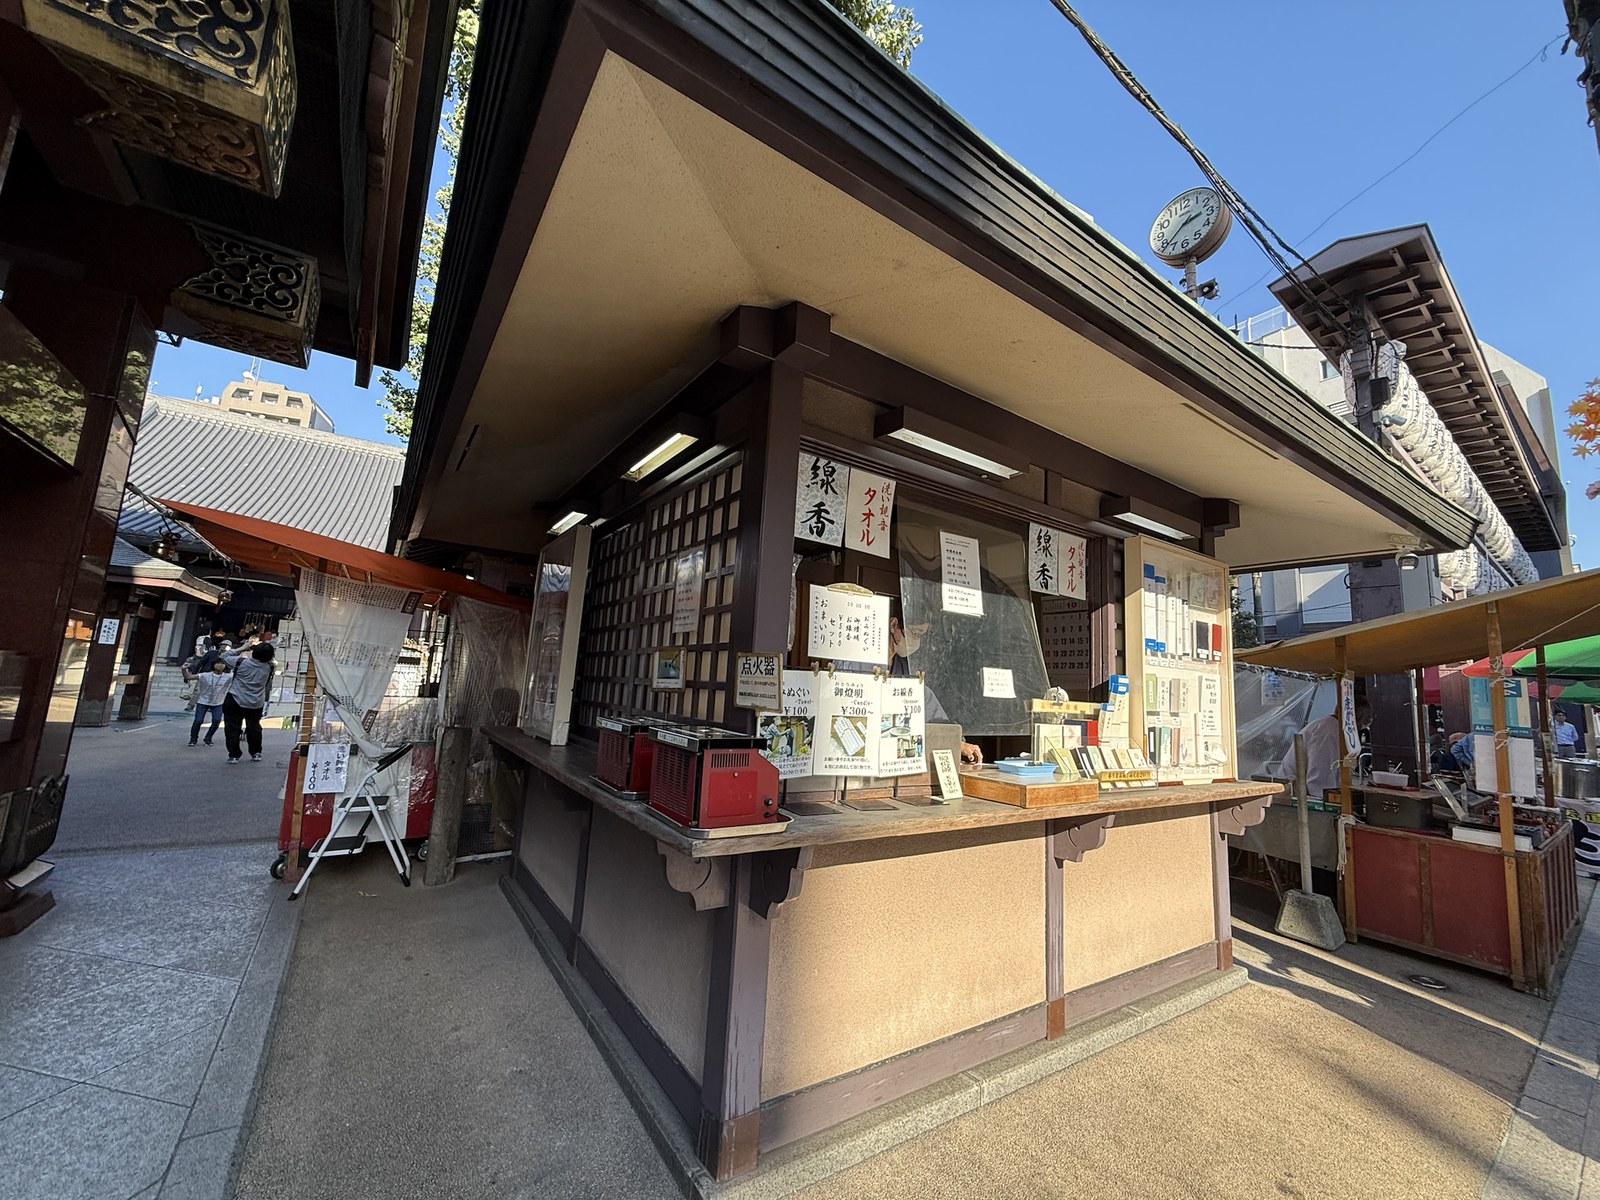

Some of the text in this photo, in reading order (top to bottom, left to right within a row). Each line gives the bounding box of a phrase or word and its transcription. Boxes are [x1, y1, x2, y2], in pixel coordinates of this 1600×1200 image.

[1180, 199, 1190, 211] 12
[1203, 197, 1210, 208] 2
[1168, 207, 1177, 218] 11
[1206, 206, 1214, 216] 3
[1157, 219, 1170, 230] 10
[1203, 218, 1210, 227] 4
[1157, 232, 1164, 241] 9
[1194, 230, 1201, 240] 5
[1161, 239, 1168, 249] 8
[1171, 241, 1178, 251] 7
[1181, 239, 1189, 248] 6
[800, 456, 838, 538] 線香
[877, 482, 893, 532] 洗い観音
[859, 488, 877, 547] タオル
[1035, 528, 1053, 591] 線香
[1067, 546, 1077, 593] タオル
[819, 598, 828, 645] おまいり
[1076, 649, 1084, 657] 22
[741, 656, 775, 676] 点火器
[834, 686, 863, 698] 御燈明
[892, 687, 913, 697] お線香
[784, 706, 808, 715] ¥100
[904, 705, 921, 714] ¥100
[308, 762, 318, 790] ¥100
[321, 761, 331, 781] タオル
